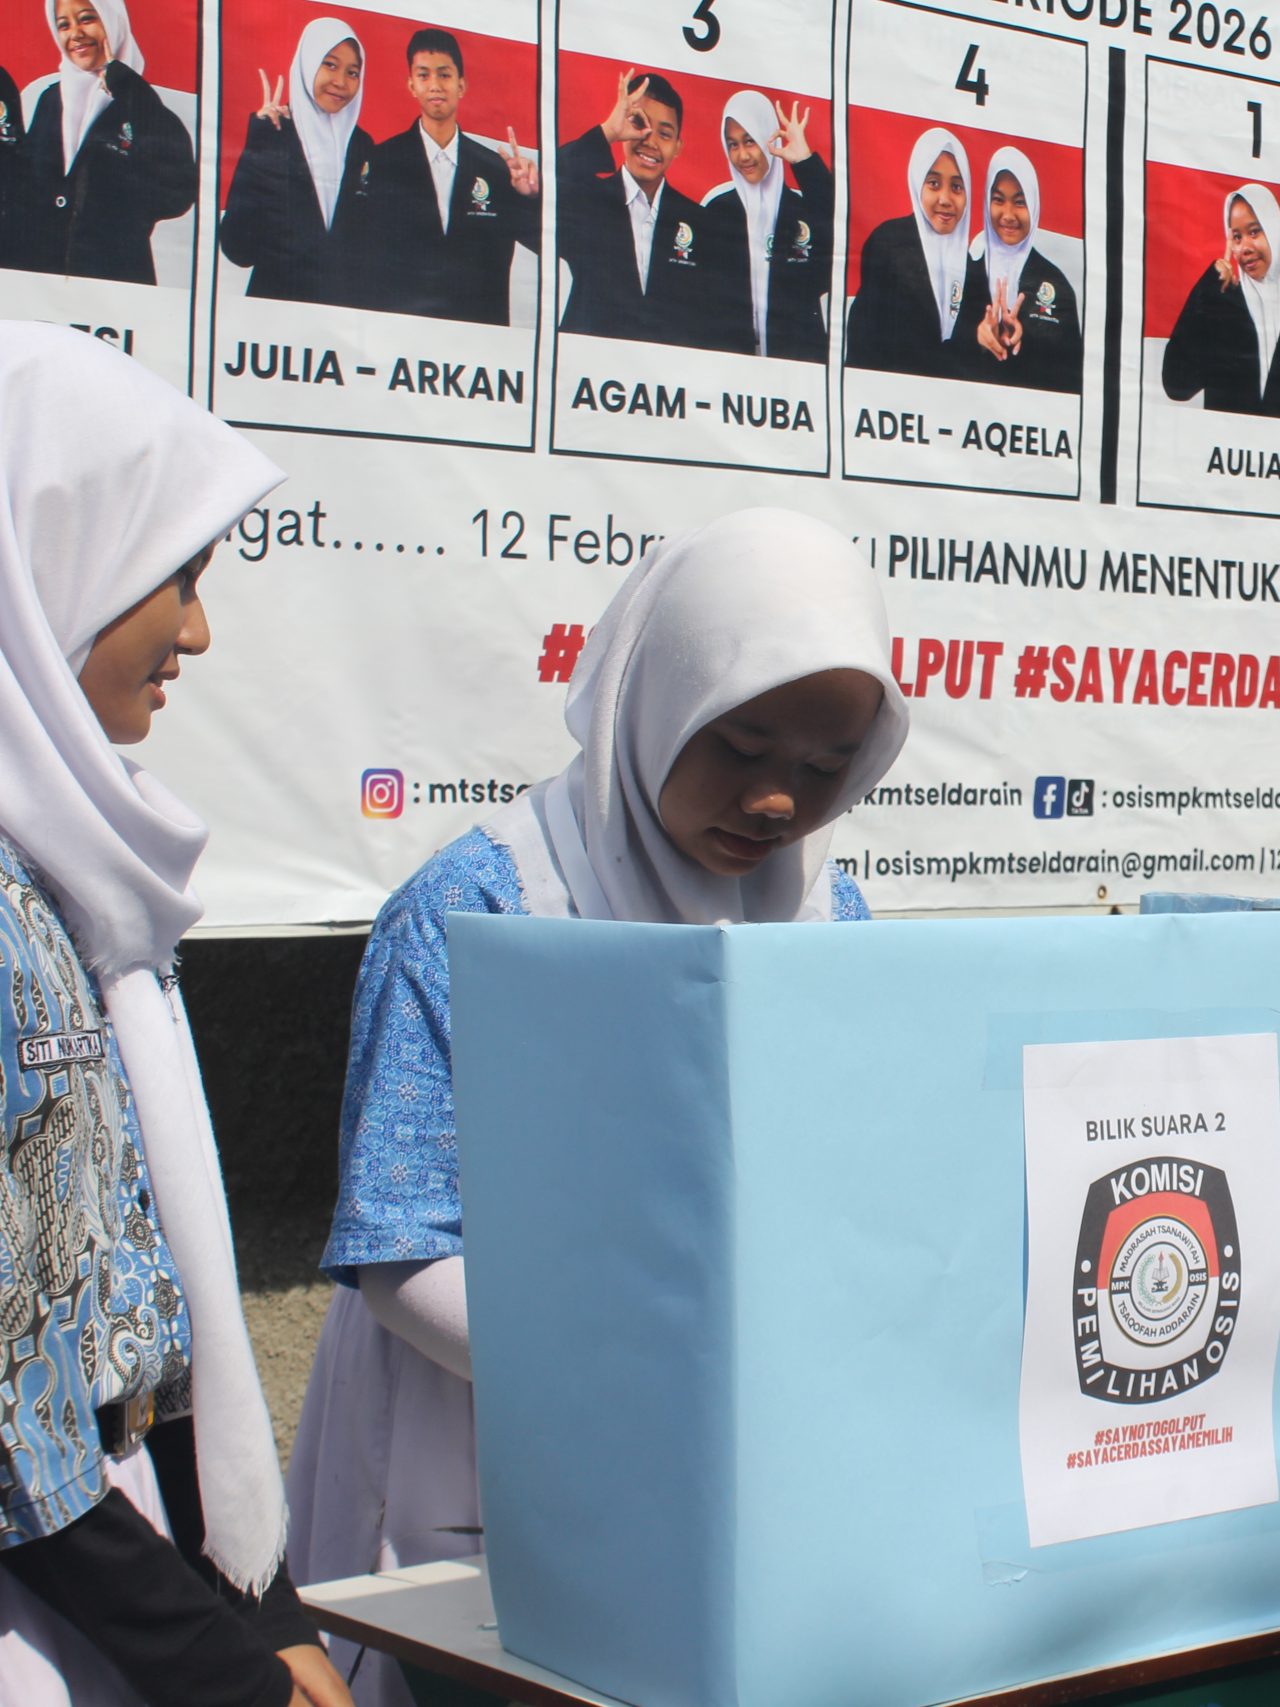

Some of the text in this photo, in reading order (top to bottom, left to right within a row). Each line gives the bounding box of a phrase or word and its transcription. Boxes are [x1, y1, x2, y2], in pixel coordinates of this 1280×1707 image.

[682, 0, 721, 53] 3
[1168, 0, 1272, 60] 2026
[955, 44, 989, 106] 4
[1247, 101, 1261, 158] 1
[224, 342, 344, 385] JULIA
[388, 358, 523, 403] ARKAN
[572, 377, 685, 419] AGAM
[723, 393, 814, 432] NUBA
[855, 409, 929, 444] ADEL
[962, 420, 1072, 459] AQEELA
[473, 509, 527, 559] 12
[548, 513, 665, 567] Febr
[889, 535, 1086, 590] PILIHANMU
[429, 779, 533, 803] mtsts
[27, 1040, 52, 1061] SITI
[1086, 1112, 1226, 1141] BILIK SUARA 2
[1111, 1163, 1204, 1205] KOMISI
[1120, 1225, 1200, 1272] MADRASAH TSANAWIYAH
[1111, 1281, 1130, 1291] MPK
[1189, 1273, 1207, 1283] OSIS
[1077, 1272, 1240, 1397] PEMILIHAN OSIS
[1118, 1300, 1157, 1337] TSAQOFAH
[1159, 1293, 1200, 1337] ADDARAIN
[1066, 1426, 1234, 1469] #SAYACERDASSAYAMEMILIH
[1094, 1413, 1206, 1446] #SAYNOTOGOLPUT
